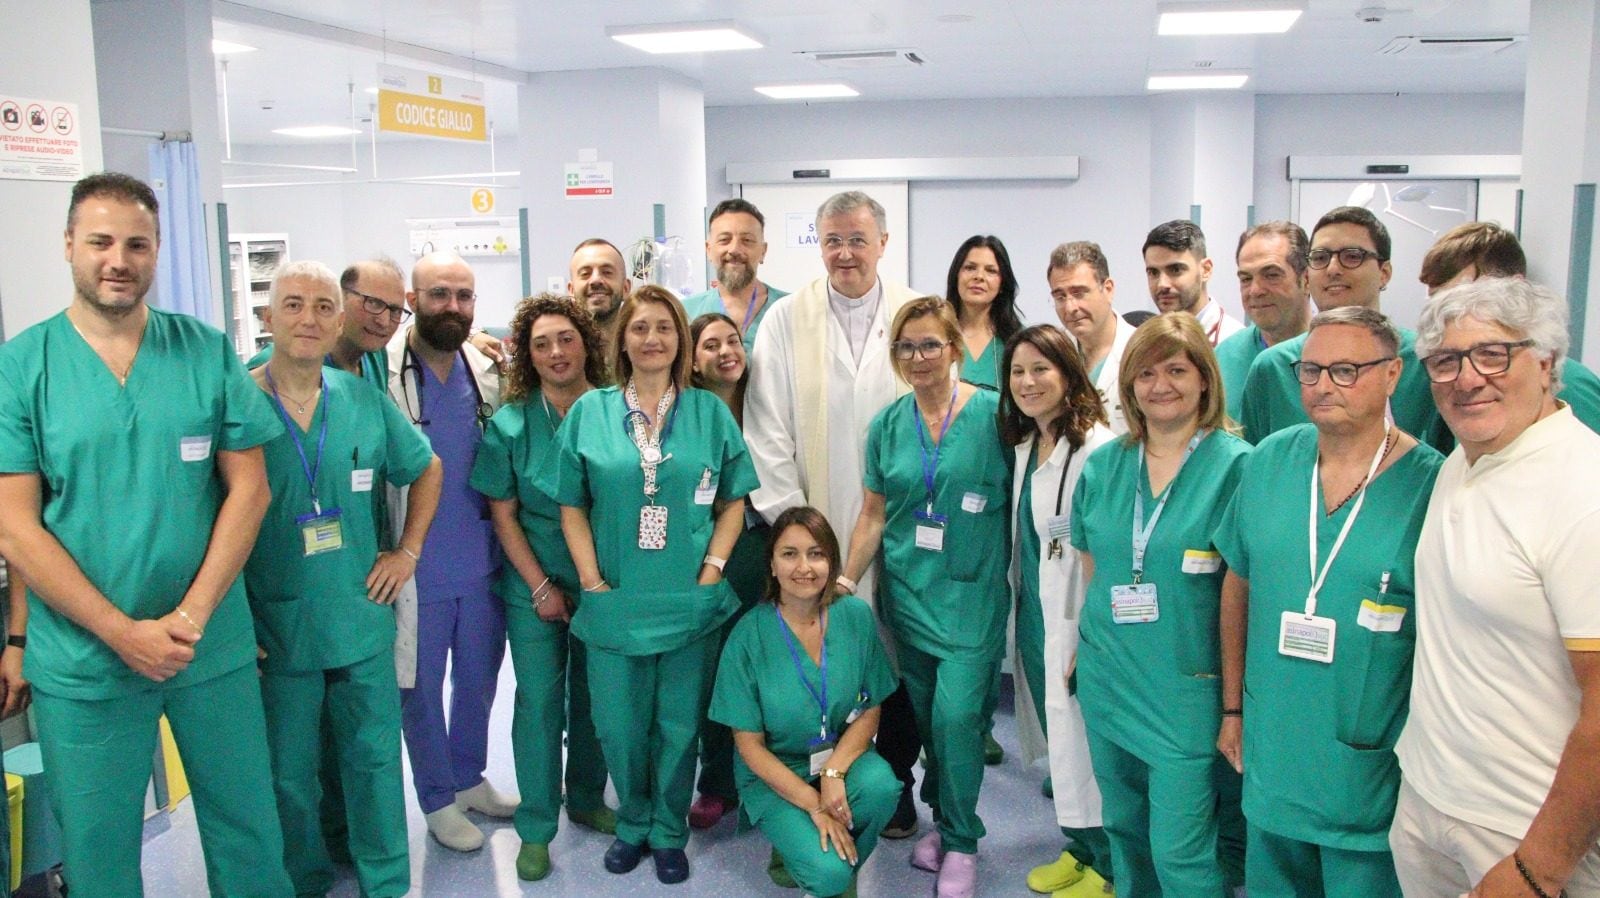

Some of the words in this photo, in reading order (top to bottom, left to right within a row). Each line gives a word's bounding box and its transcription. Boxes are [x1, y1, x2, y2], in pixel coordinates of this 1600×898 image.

[432, 77, 440, 92] 2
[396, 102, 436, 128] CODICE
[438, 108, 473, 132] GIALLO
[25, 137, 62, 146] EFFETTUARE
[10, 144, 35, 153] RIPRESE
[36, 146, 74, 155] AUDIO-VIDEO
[476, 190, 489, 210] 3
[798, 235, 819, 245] LAV
